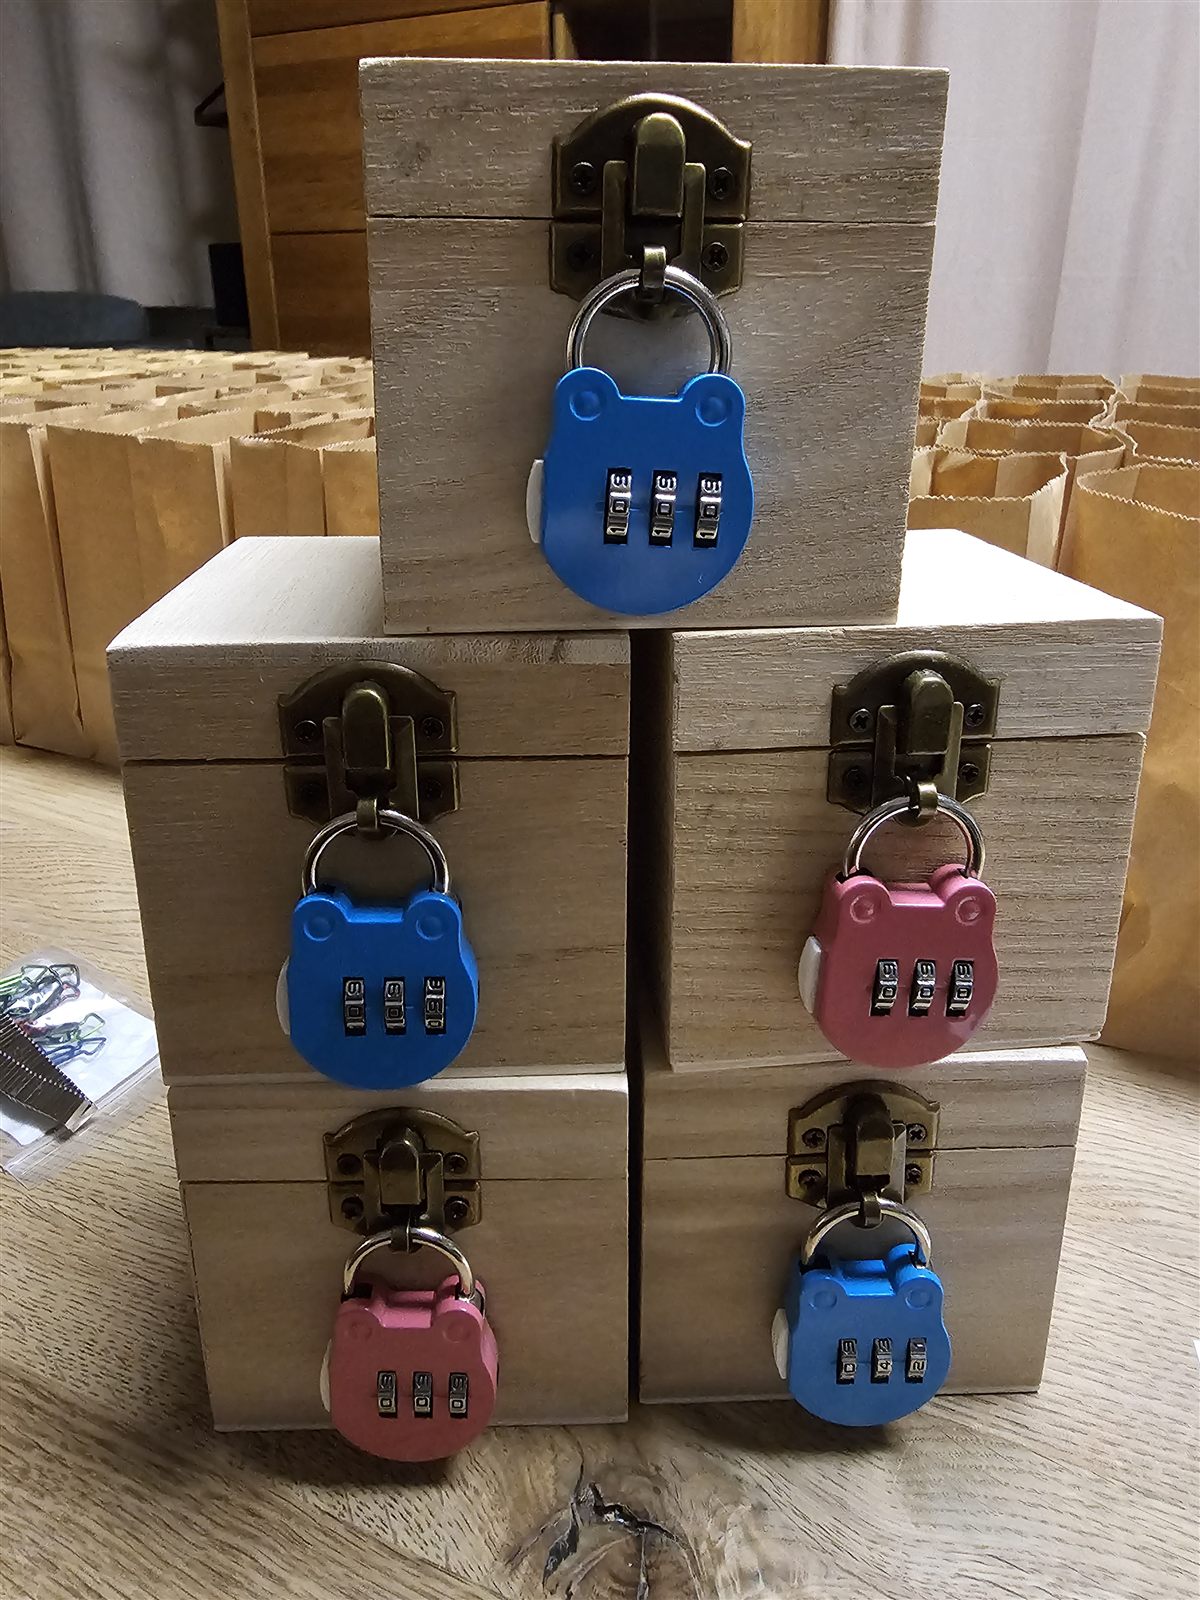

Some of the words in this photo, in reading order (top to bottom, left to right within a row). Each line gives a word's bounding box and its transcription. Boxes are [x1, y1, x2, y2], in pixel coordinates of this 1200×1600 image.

[612, 500, 628, 513] 0
[658, 502, 673, 516] 0
[702, 504, 717, 518] 0
[882, 986, 896, 999] 0
[919, 985, 934, 999] 0
[956, 986, 971, 999] 0
[380, 1398, 392, 1408] 0
[415, 1397, 428, 1407] 0
[451, 1399, 464, 1409] 0
